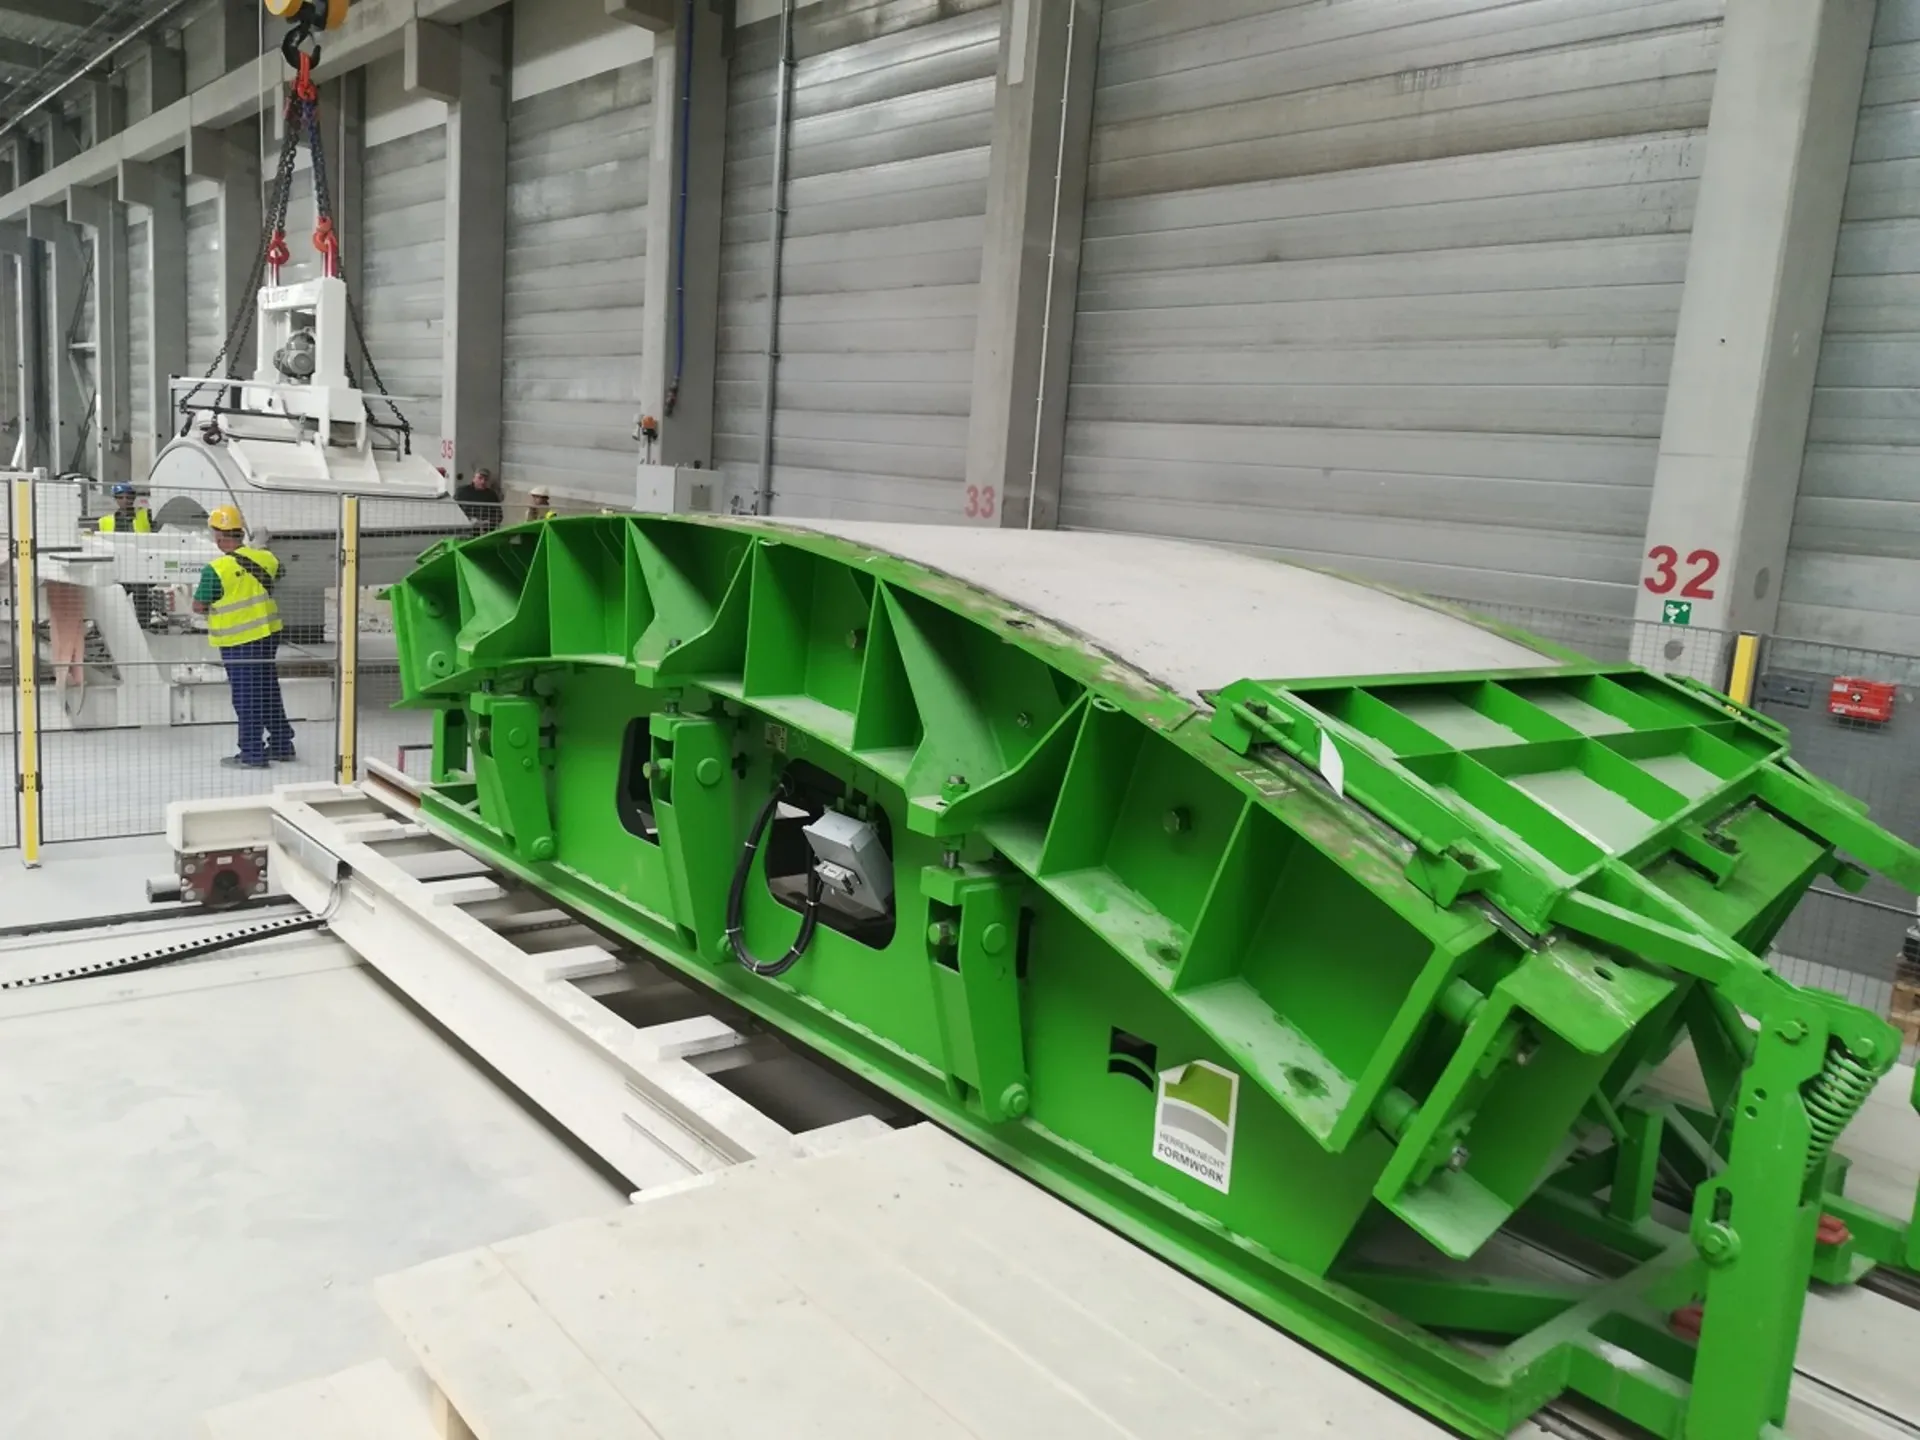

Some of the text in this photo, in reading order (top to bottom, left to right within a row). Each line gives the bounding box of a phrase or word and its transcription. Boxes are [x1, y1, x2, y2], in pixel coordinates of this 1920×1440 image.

[441, 439, 453, 459] 35
[965, 485, 994, 518] 33
[1644, 545, 1720, 600] 32
[1158, 1143, 1224, 1184] FORMWORK
